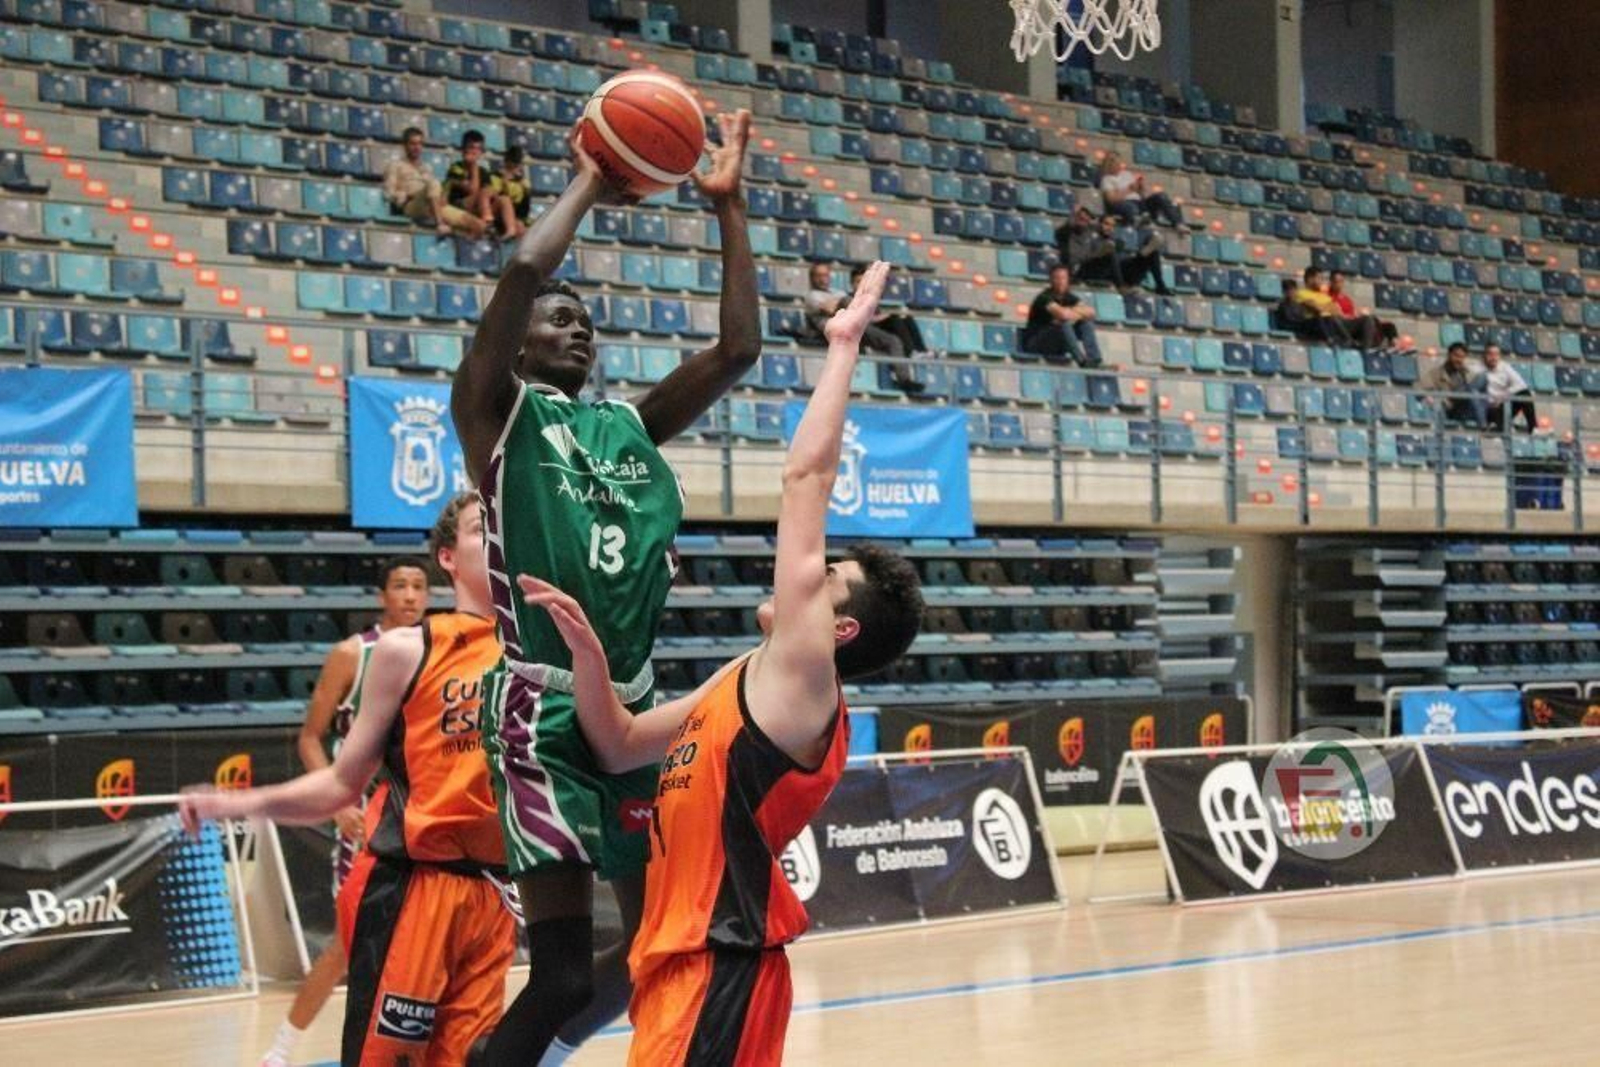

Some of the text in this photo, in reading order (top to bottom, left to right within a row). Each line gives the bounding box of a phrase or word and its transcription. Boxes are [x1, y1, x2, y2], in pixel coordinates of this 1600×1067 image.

[0, 460, 87, 487] UELVA
[867, 482, 941, 504] HUELVA
[588, 522, 626, 574] 13
[827, 817, 965, 848] Federación Andaluza
[856, 845, 948, 874] de Baloncesto
